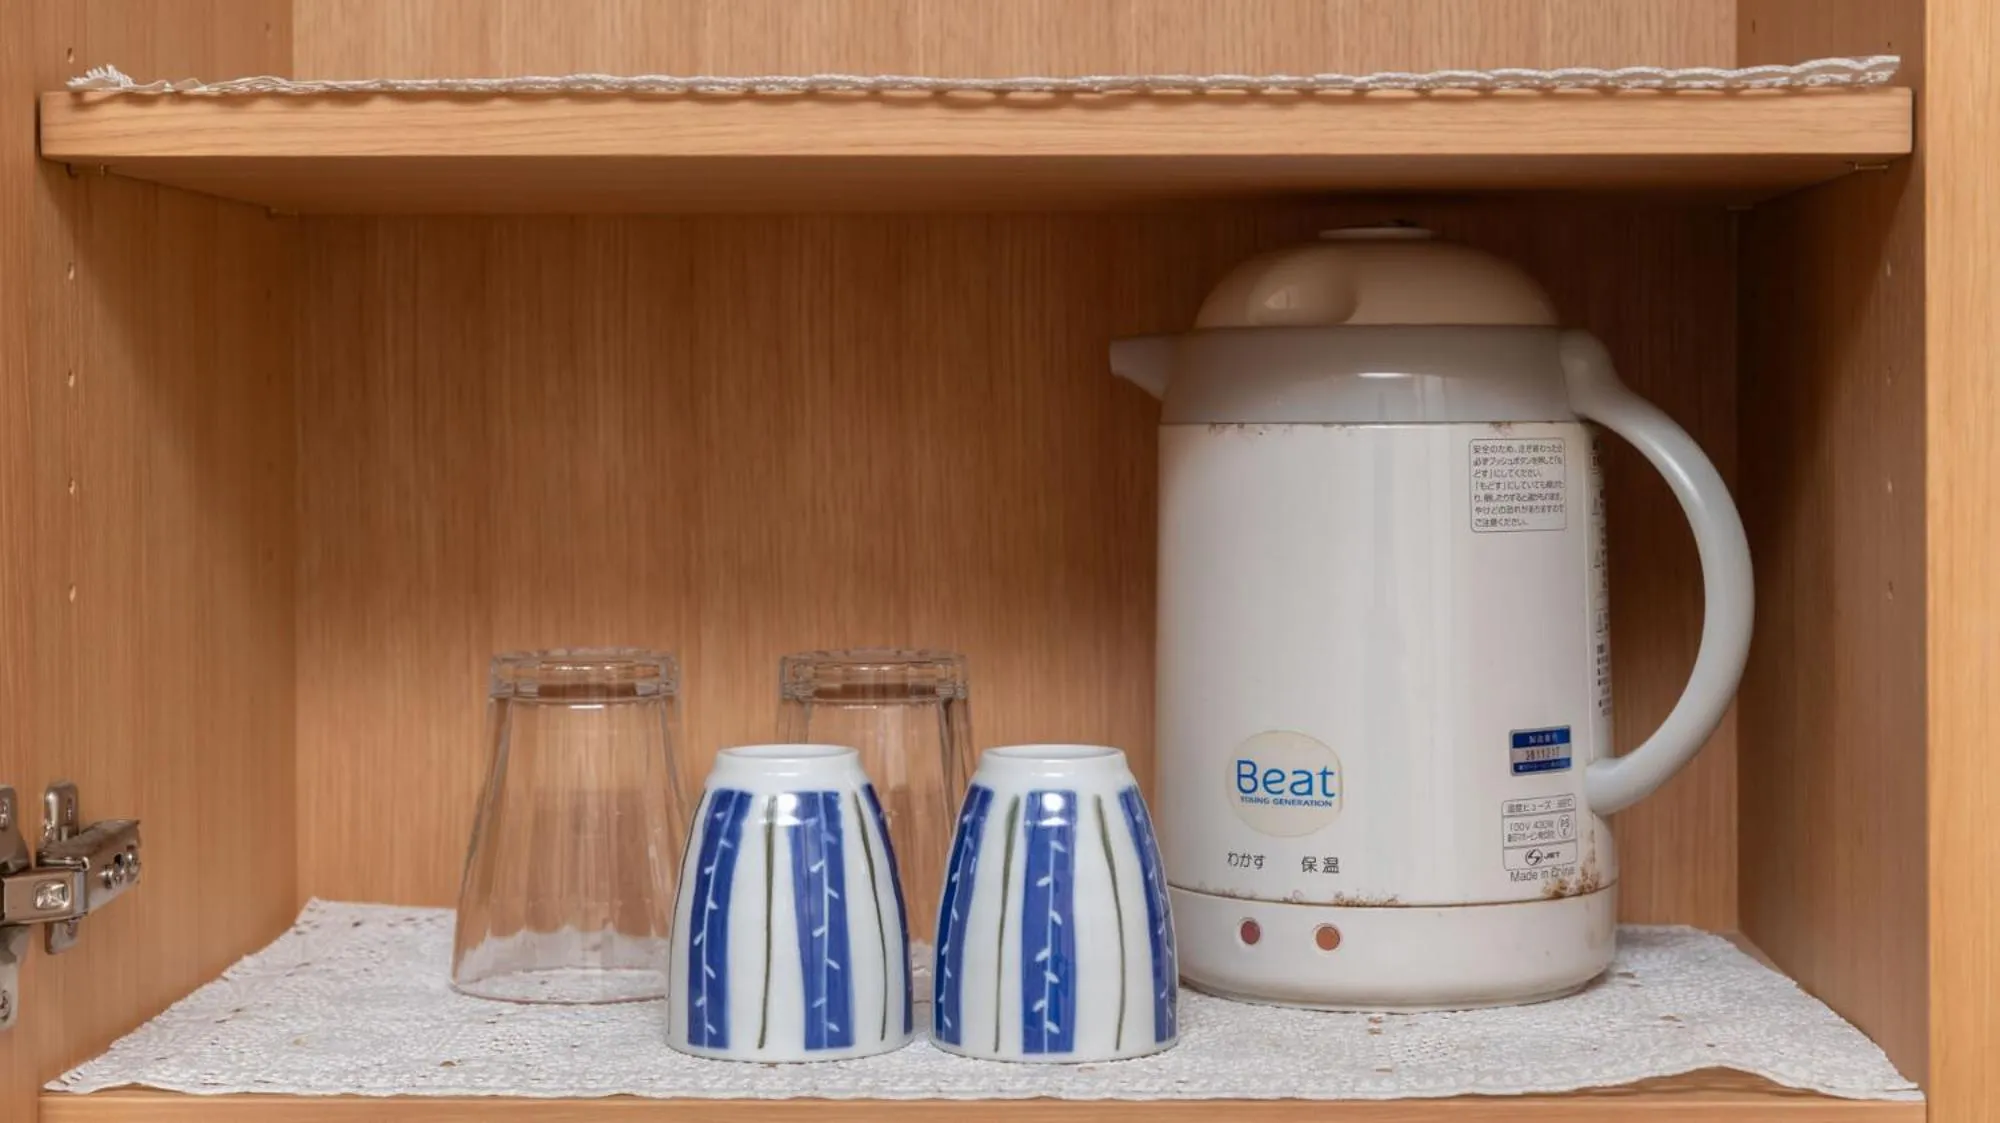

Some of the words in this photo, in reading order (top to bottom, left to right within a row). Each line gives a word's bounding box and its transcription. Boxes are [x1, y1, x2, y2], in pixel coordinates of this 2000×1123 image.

[1236, 759, 1336, 798] Beat
[1239, 795, 1270, 806] YOUNG
[1272, 797, 1333, 808] GENERATION
[1227, 851, 1267, 870] わかす
[1301, 855, 1340, 874] 保温
[1544, 851, 1561, 861] JET
[1510, 869, 1538, 883] Made
[1540, 868, 1549, 879] in
